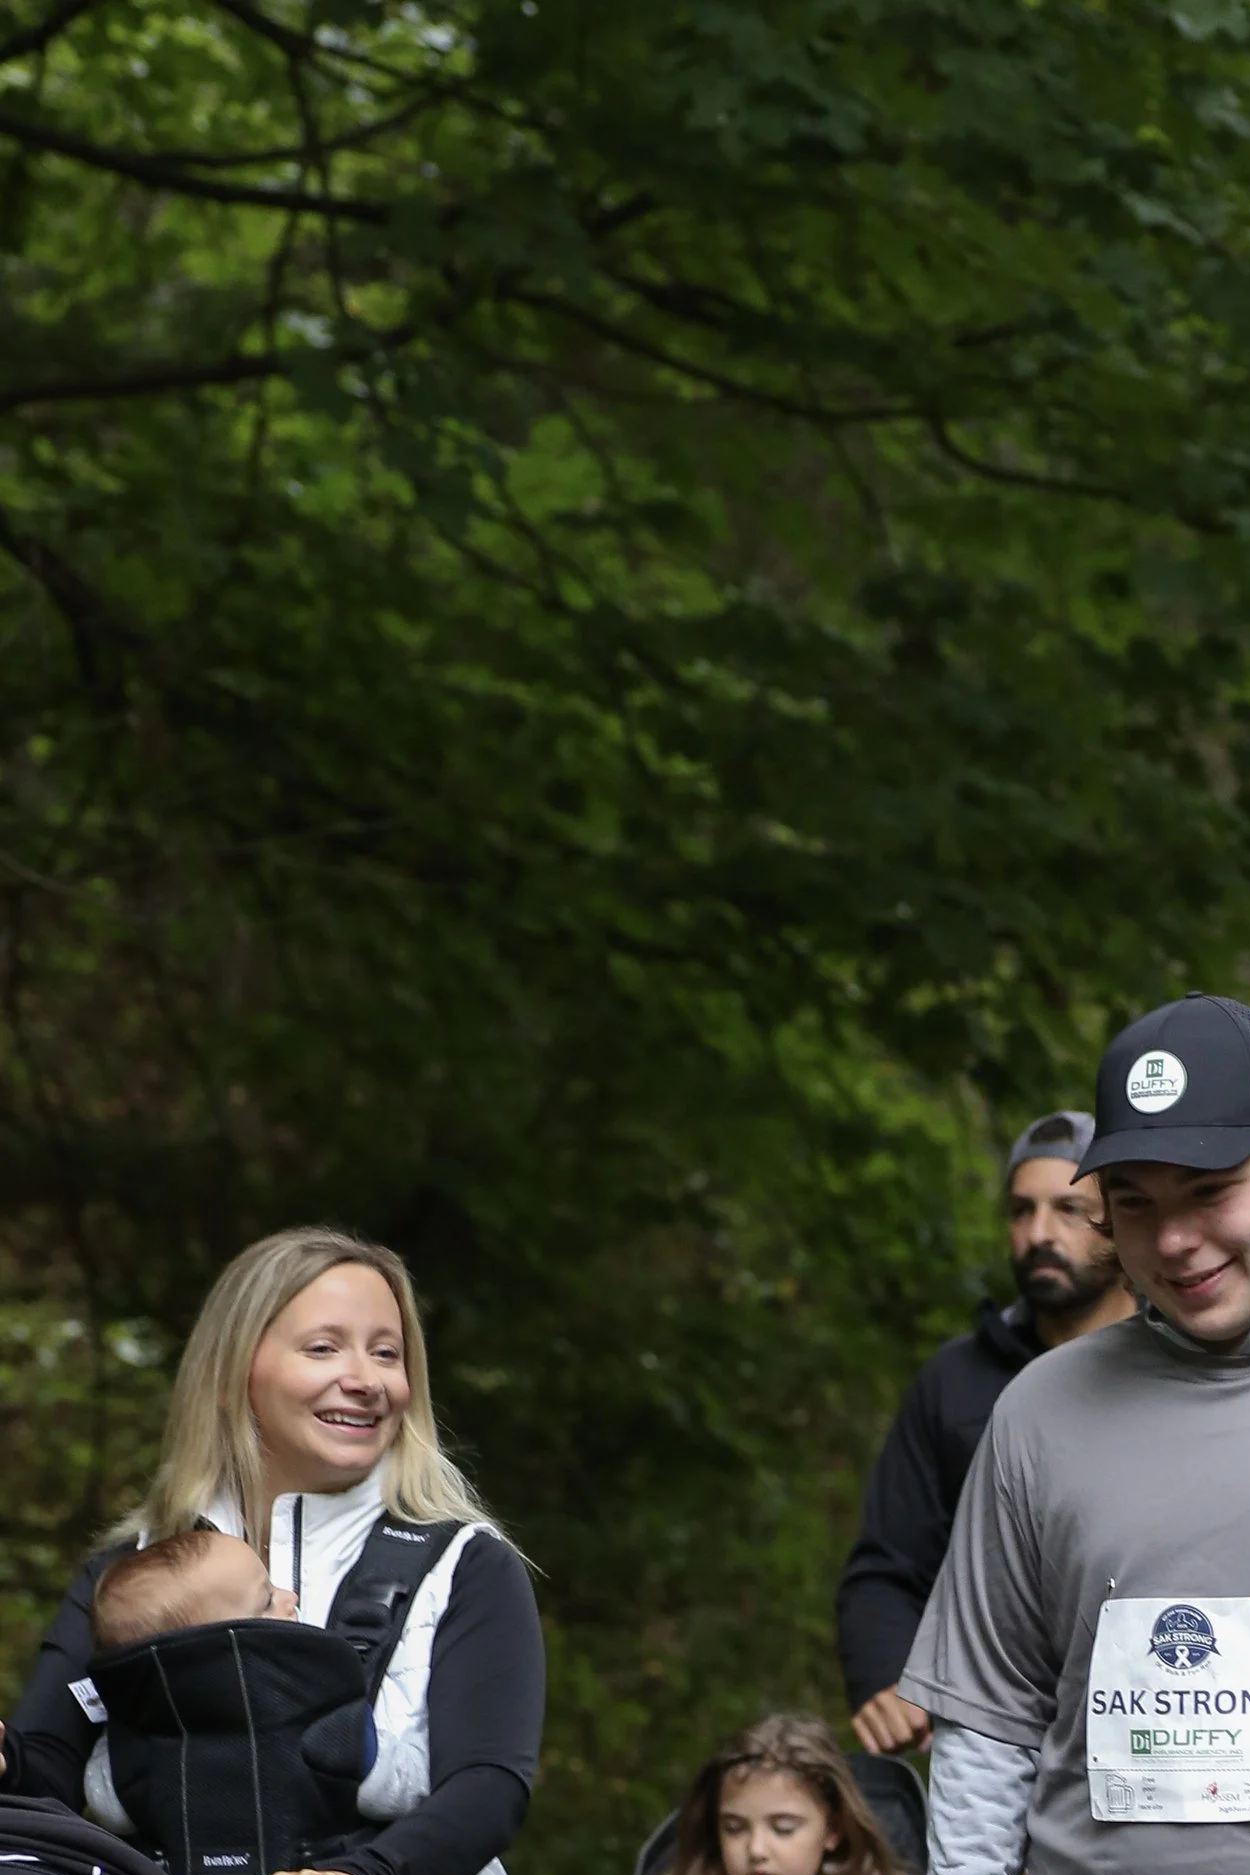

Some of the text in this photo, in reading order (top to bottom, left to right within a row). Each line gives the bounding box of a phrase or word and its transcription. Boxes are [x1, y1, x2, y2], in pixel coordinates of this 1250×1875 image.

[1131, 1079, 1177, 1091] DUFFY
[1153, 1632, 1213, 1645] SAK STRONG
[1092, 1690, 1147, 1716] SAK
[1153, 1729, 1242, 1746] DUFFY
